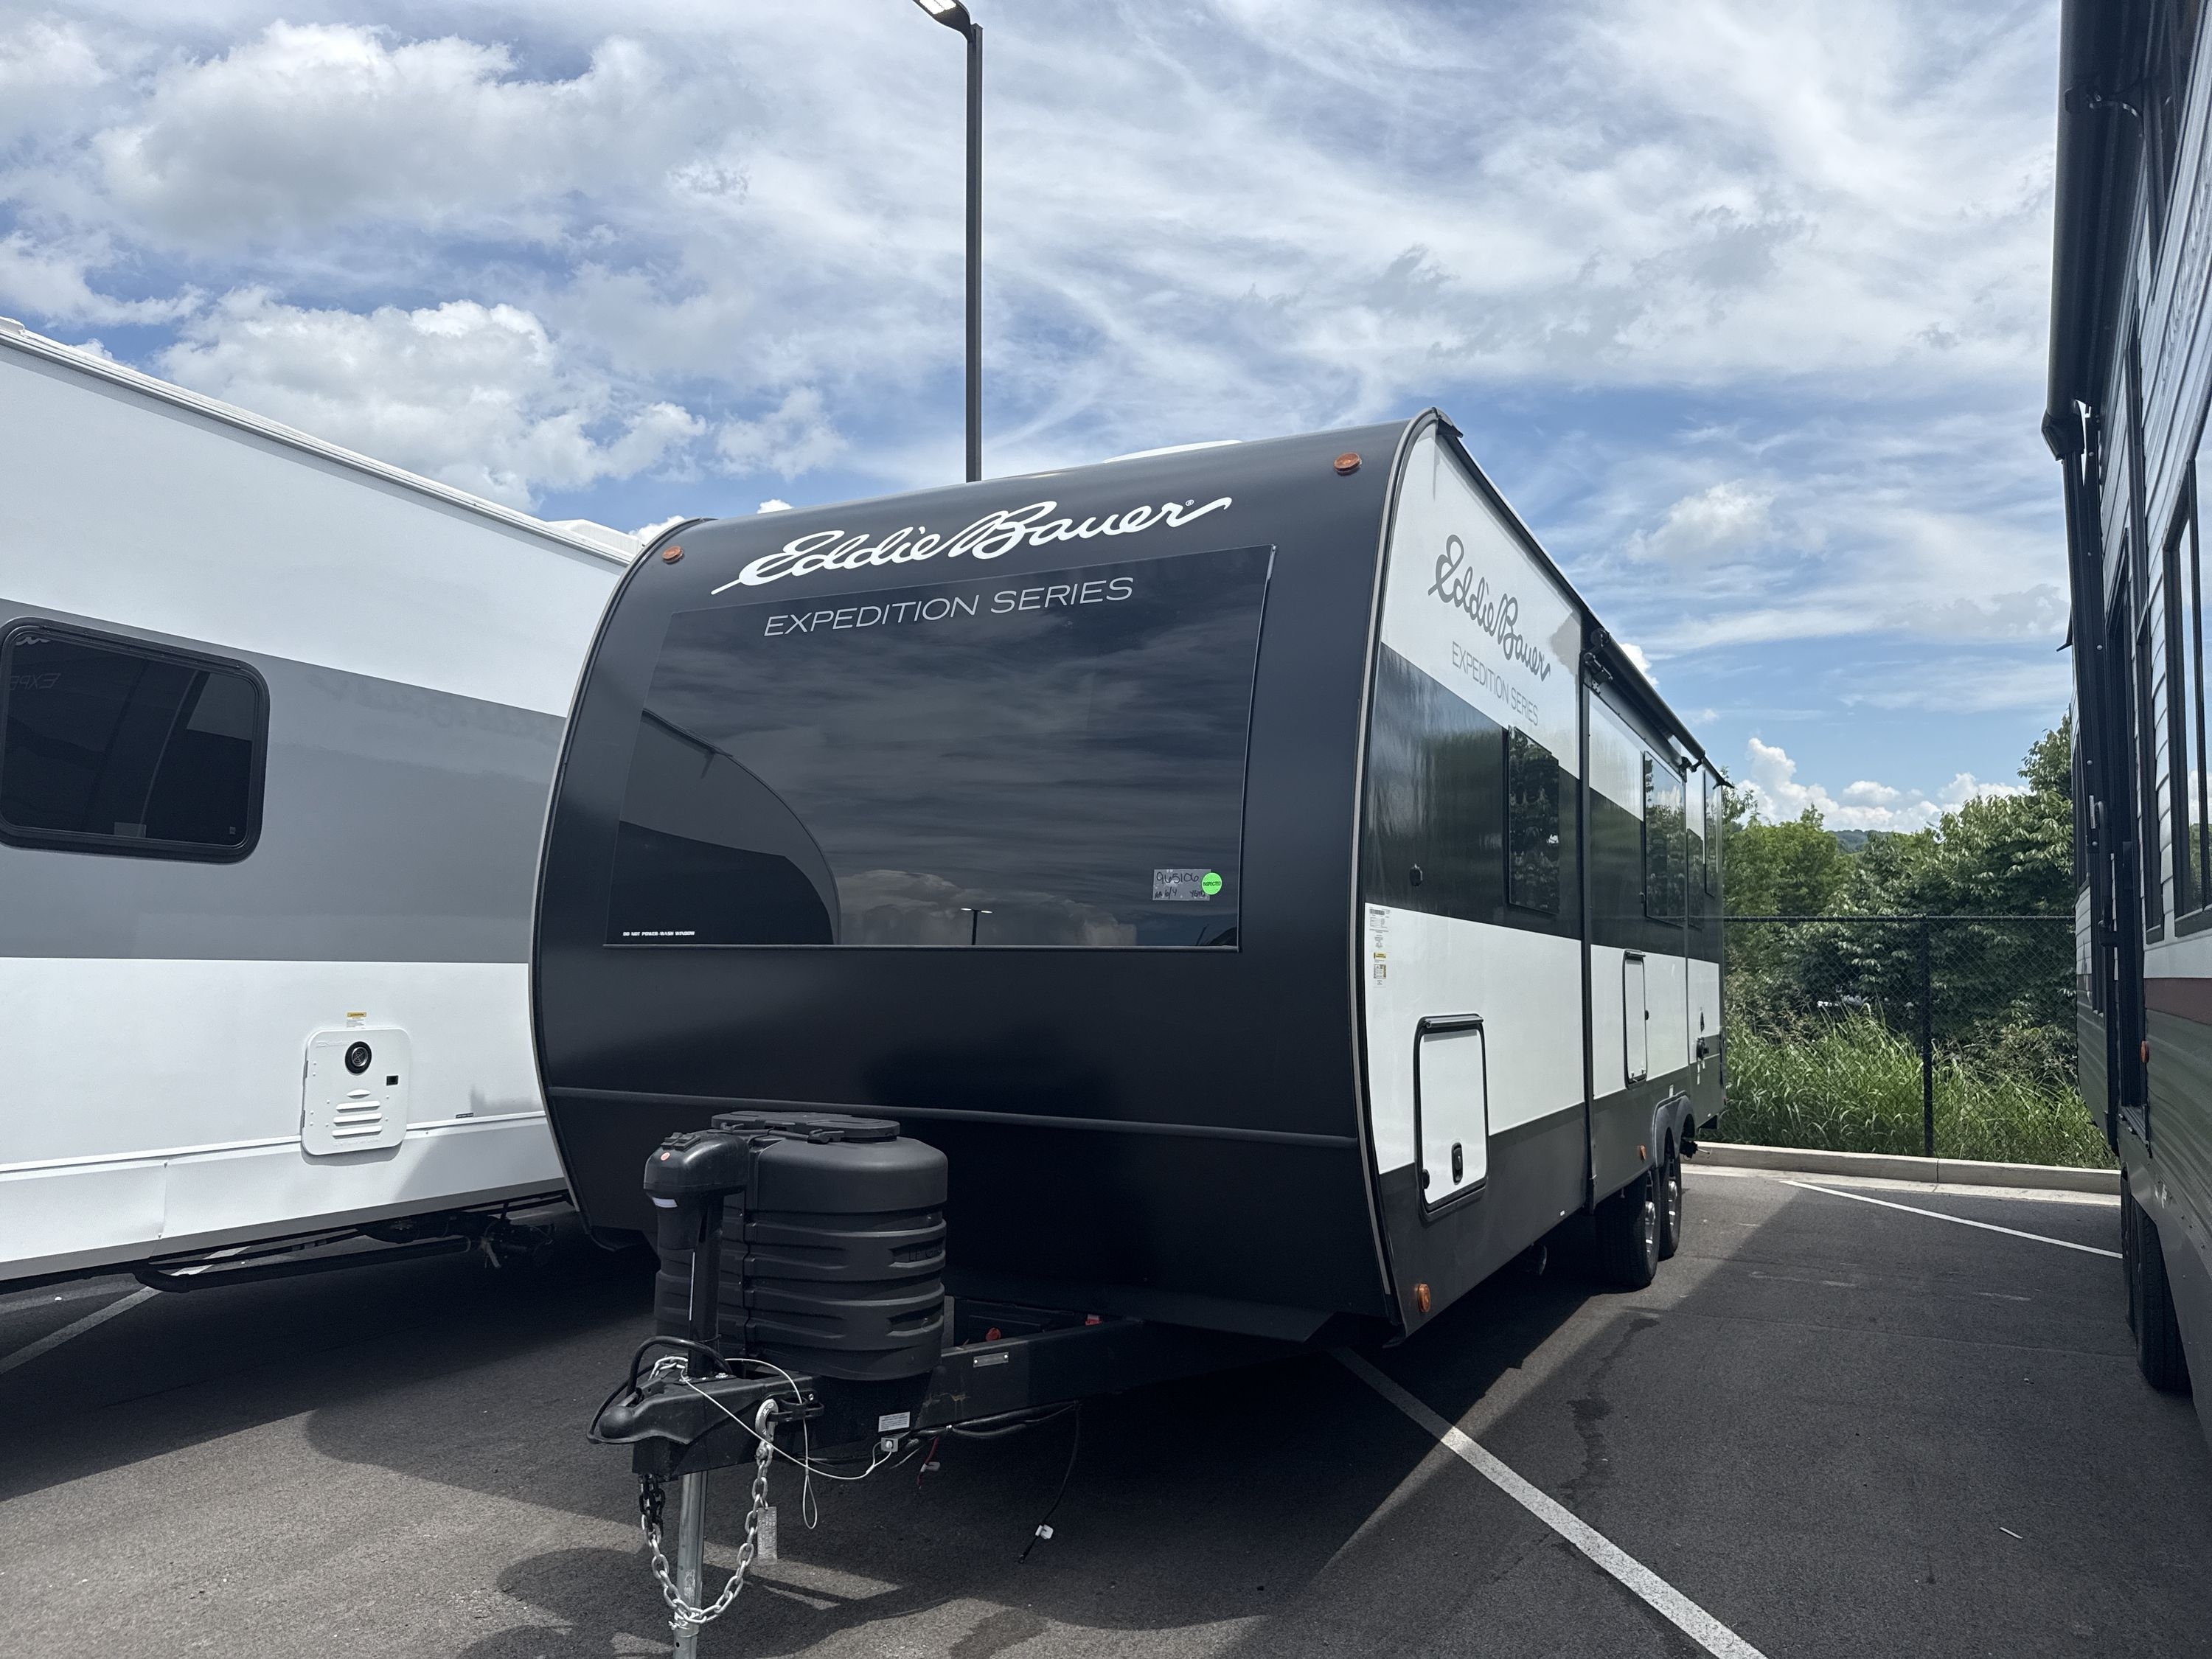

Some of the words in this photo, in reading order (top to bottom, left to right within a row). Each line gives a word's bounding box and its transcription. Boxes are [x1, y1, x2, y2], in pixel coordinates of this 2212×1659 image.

[710, 526, 945, 596] Eddie
[947, 496, 1233, 561] Bauer
[763, 594, 980, 636] EXPEDITION
[990, 577, 1134, 613] SERIES
[1427, 534, 1495, 637] Eddie
[1496, 593, 1551, 683] Bauer
[1452, 640, 1510, 705] EXPEDITION
[1511, 686, 1539, 726] SERIES
[1156, 872, 1199, 884] 965106
